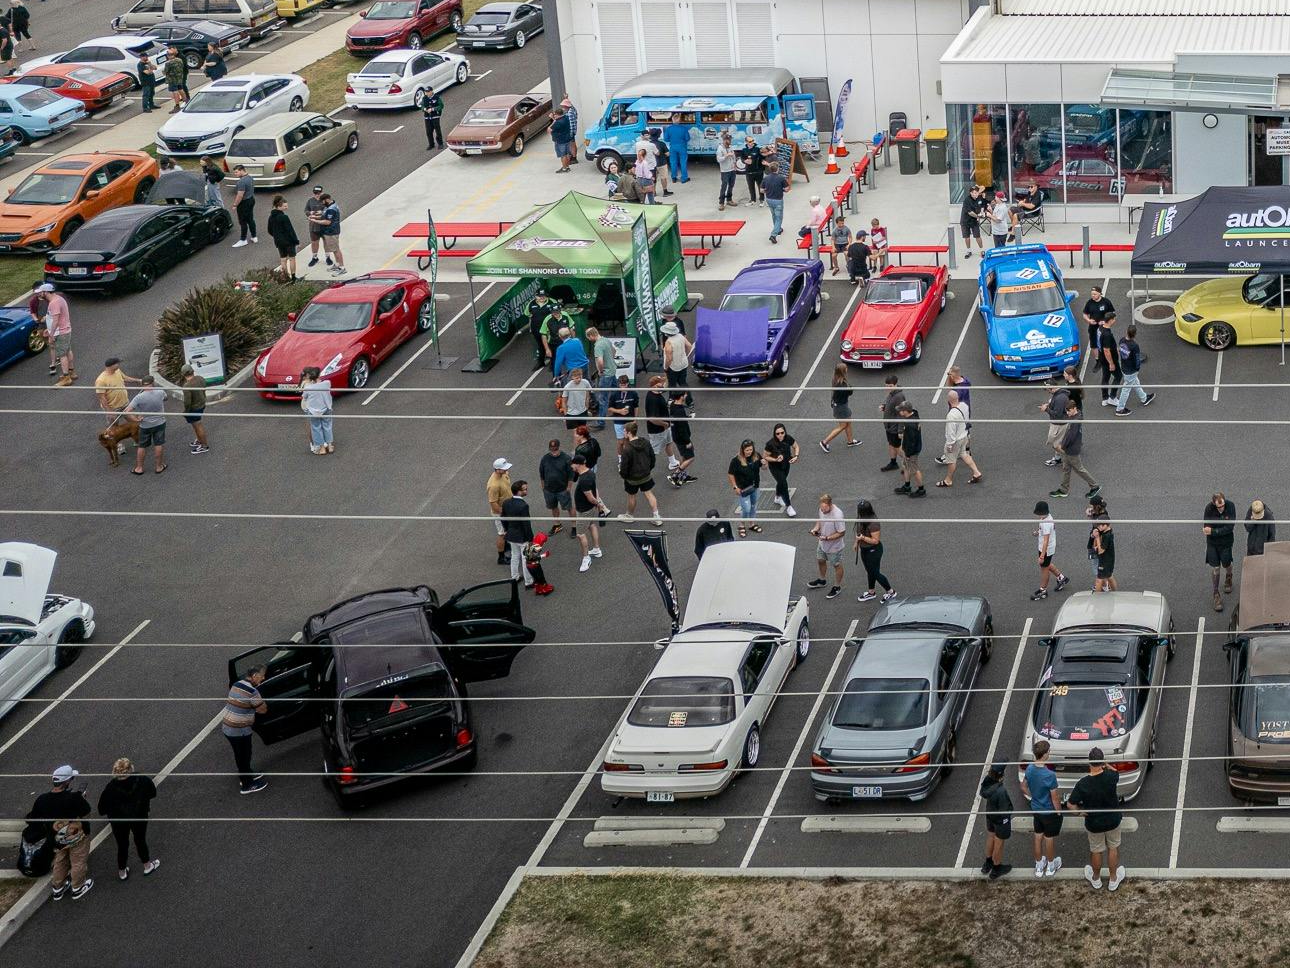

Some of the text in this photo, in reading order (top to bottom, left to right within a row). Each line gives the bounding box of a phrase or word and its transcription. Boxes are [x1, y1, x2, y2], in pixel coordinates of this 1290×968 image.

[518, 267, 557, 275] SHANNONS
[558, 267, 577, 275] CLUB
[1013, 283, 1042, 291] NISSAN
[1047, 314, 1063, 326] 12
[1020, 342, 1055, 352] NISSAN
